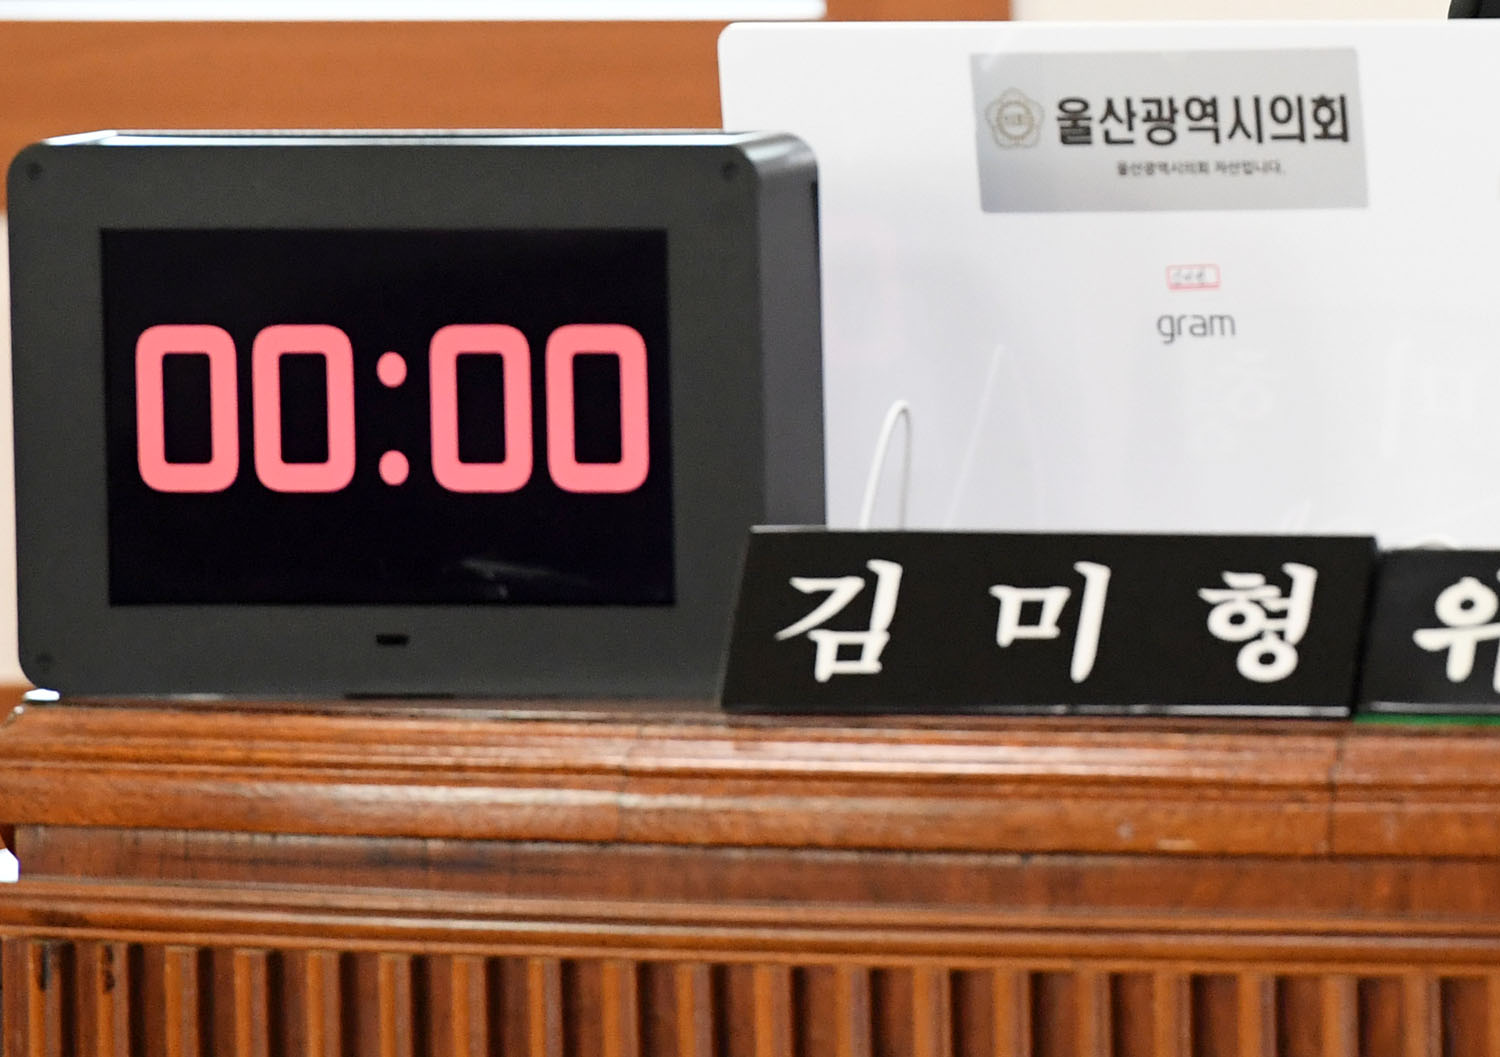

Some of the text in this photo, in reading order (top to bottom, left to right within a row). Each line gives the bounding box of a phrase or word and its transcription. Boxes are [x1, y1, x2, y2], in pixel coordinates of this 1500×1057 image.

[1056, 94, 1351, 147] 울산광역시의회
[1156, 314, 1236, 345] gram
[135, 324, 650, 493] 00:00
[777, 559, 1318, 682] 김미형
